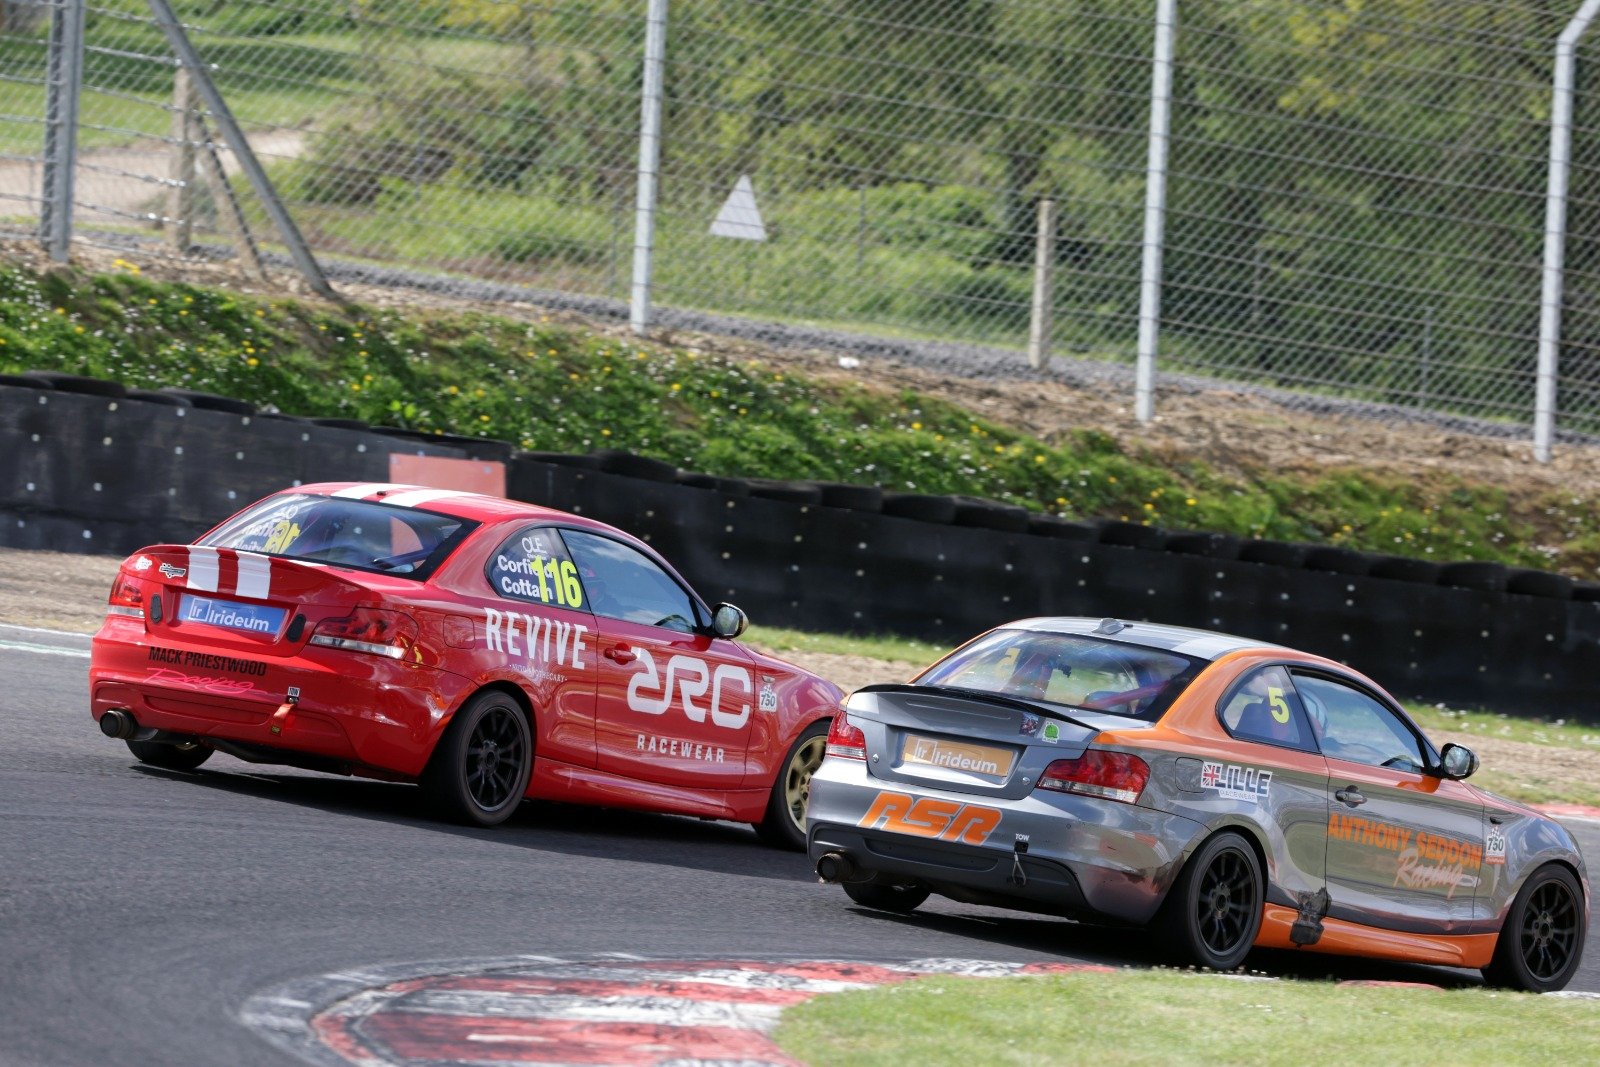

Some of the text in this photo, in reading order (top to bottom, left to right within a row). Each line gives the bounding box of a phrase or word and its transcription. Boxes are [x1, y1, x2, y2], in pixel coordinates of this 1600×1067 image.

[497, 554, 554, 578] Corfid
[531, 555, 582, 608] 116
[208, 609, 270, 632] Irideum
[483, 607, 589, 670] REVIVE
[148, 646, 268, 677] MACK PRIESTWOOD
[760, 693, 776, 707] 750
[1267, 686, 1290, 724] 5
[637, 734, 725, 763] RACEWEAR
[934, 751, 998, 774] Irideum
[856, 790, 1003, 847] RSR
[1015, 833, 1030, 842] TOW
[1327, 811, 1484, 869] ANTHONY SEDDON
[1487, 837, 1504, 851] 750
[1393, 847, 1470, 900] Racing
